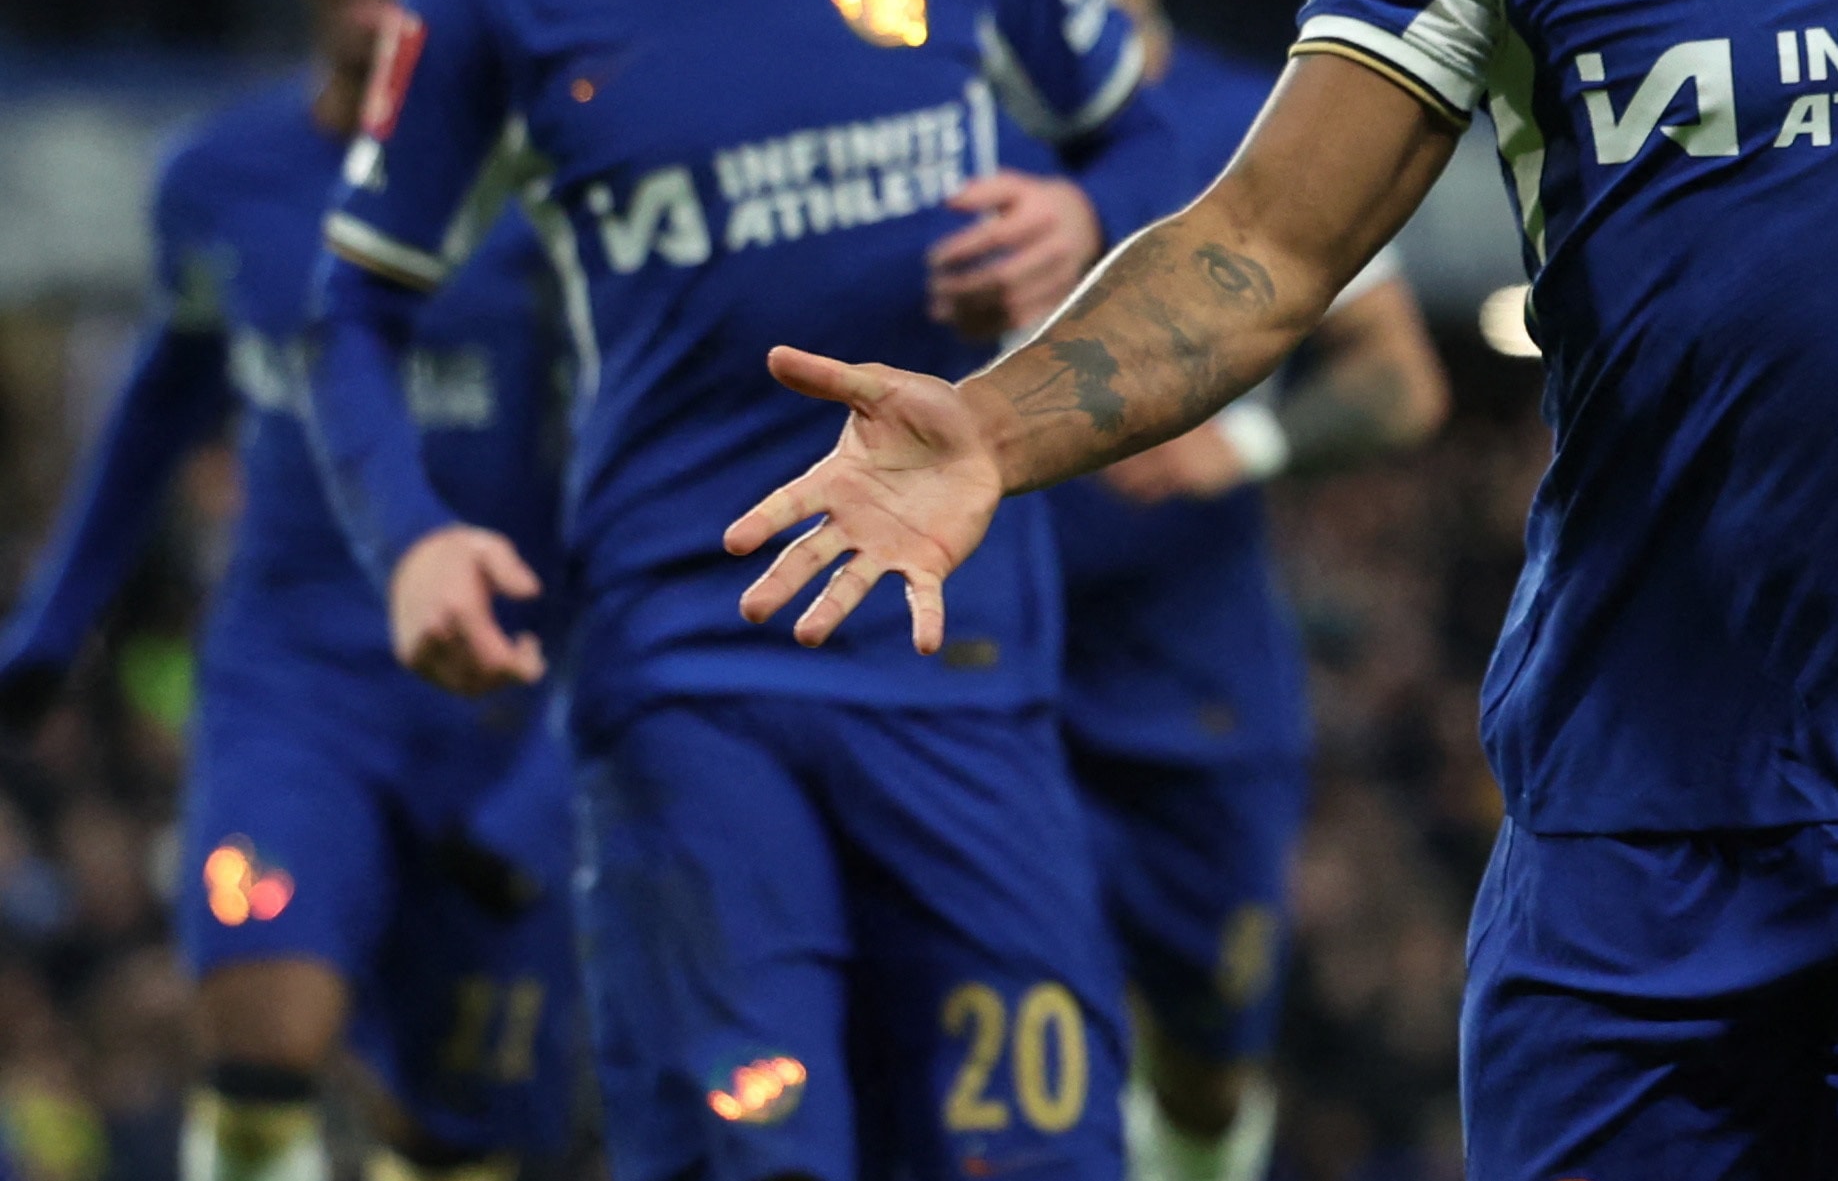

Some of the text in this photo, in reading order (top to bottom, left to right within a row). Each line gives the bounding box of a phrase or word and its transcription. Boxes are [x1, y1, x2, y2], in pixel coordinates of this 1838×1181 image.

[714, 101, 965, 202] INFINITE
[724, 158, 964, 253] ATHLETE
[941, 980, 1089, 1135] 20
